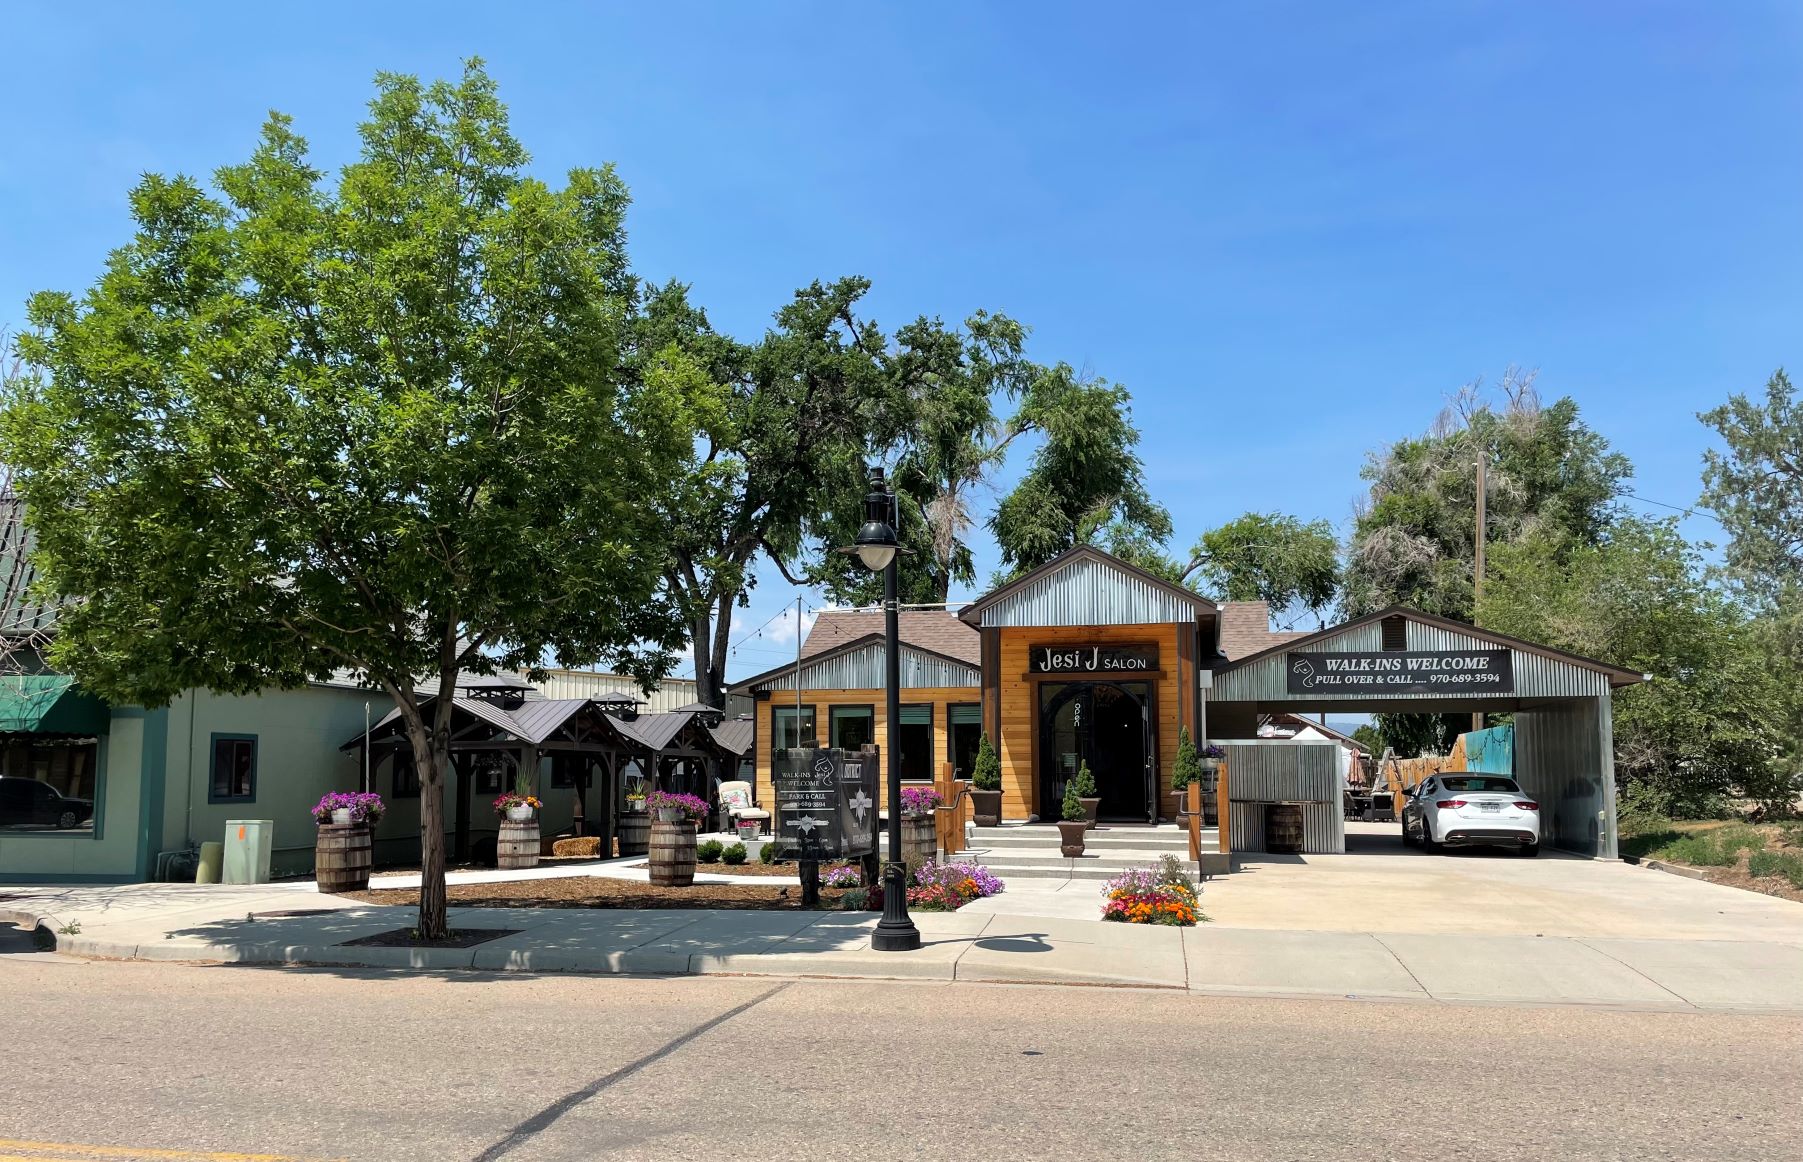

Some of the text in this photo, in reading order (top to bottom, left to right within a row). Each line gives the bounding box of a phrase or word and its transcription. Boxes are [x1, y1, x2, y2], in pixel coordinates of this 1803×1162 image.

[1039, 646, 1146, 672] Jesi J SALON
[1326, 656, 1490, 671] WALK-INS WELCOME
[1315, 675, 1342, 684] PULL
[1345, 675, 1374, 684] OVER
[1376, 675, 1384, 684] &
[1387, 675, 1413, 684] CALL
[1430, 673, 1500, 684] 970-689-3594
[1073, 702, 1081, 727] open
